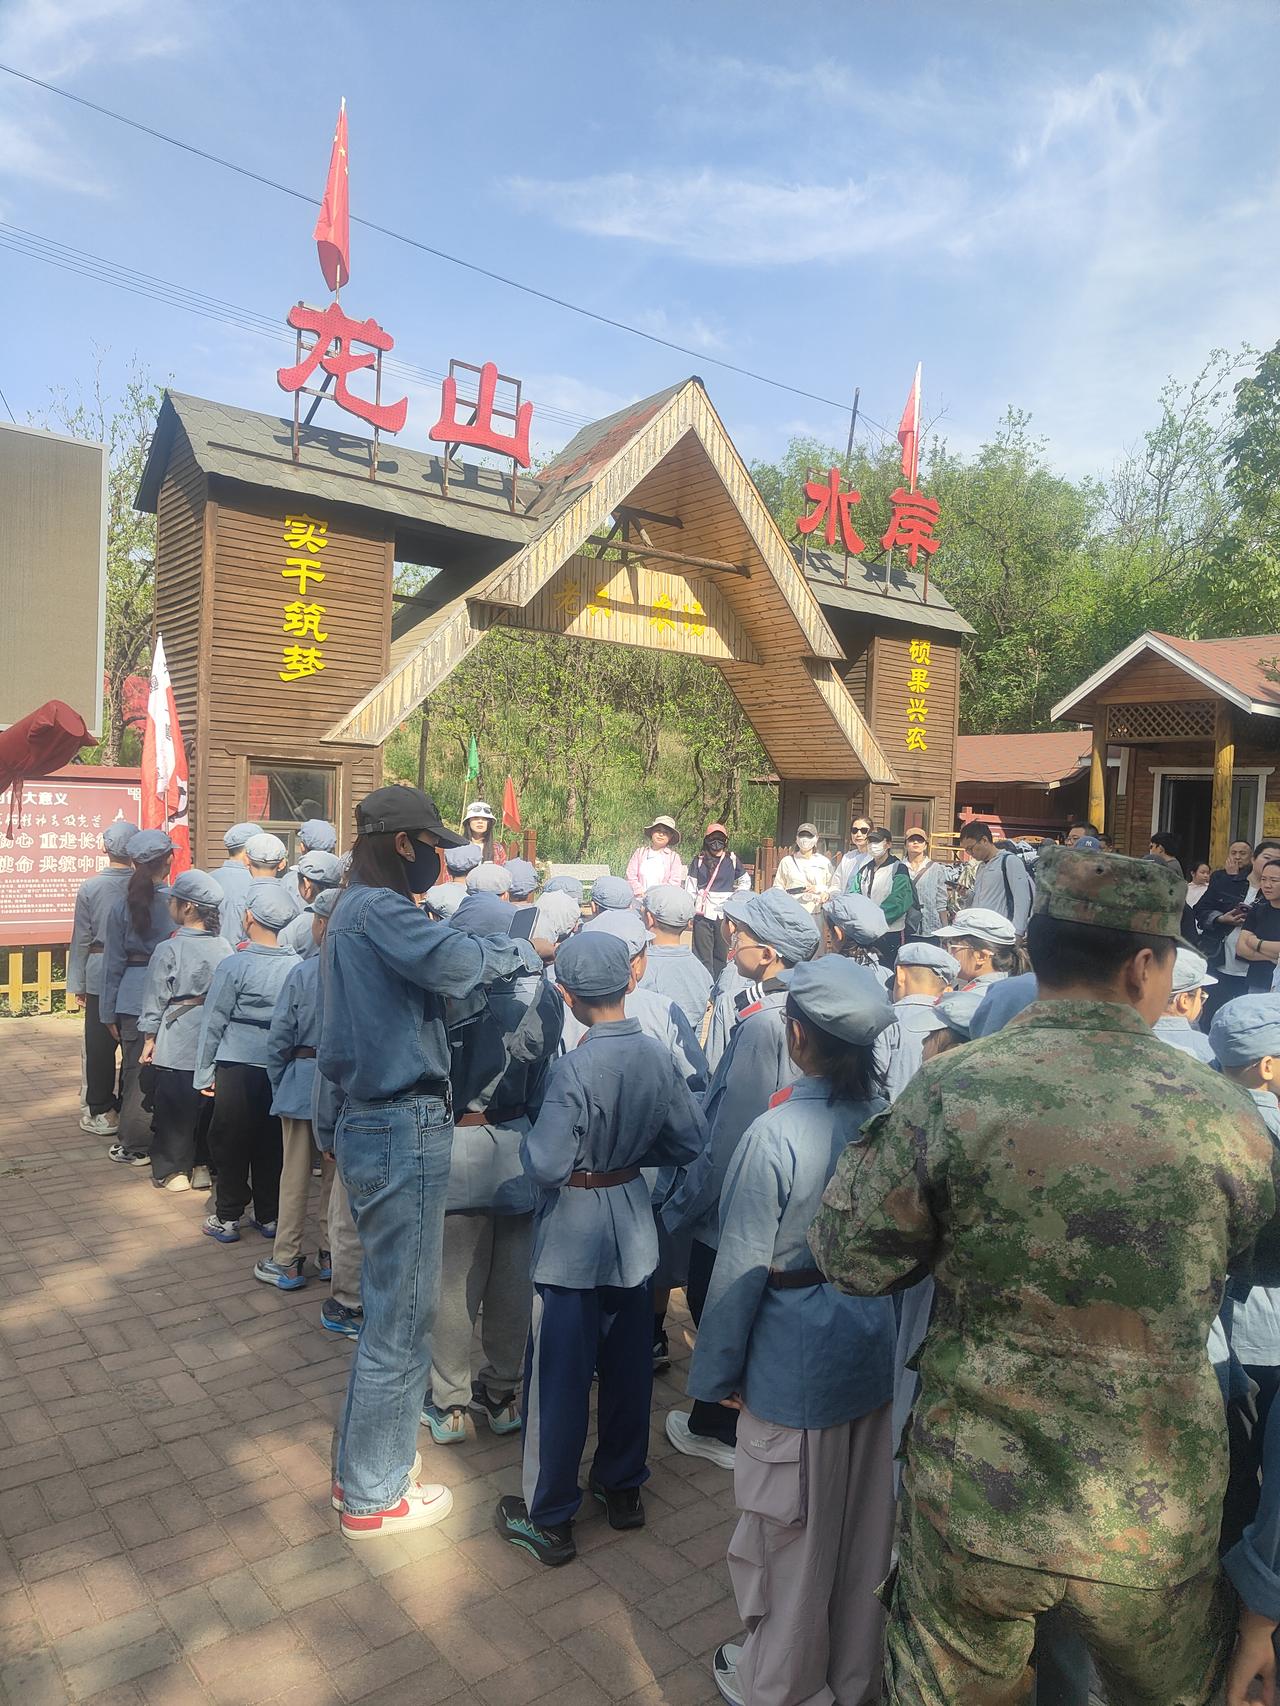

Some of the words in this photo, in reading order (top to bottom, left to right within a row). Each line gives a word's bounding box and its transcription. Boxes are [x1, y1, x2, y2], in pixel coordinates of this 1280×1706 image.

[277, 301, 533, 468] 龙山
[796, 466, 941, 567] 水岸
[278, 514, 330, 683] 实干筑梦
[904, 638, 932, 752] 硕果兴农
